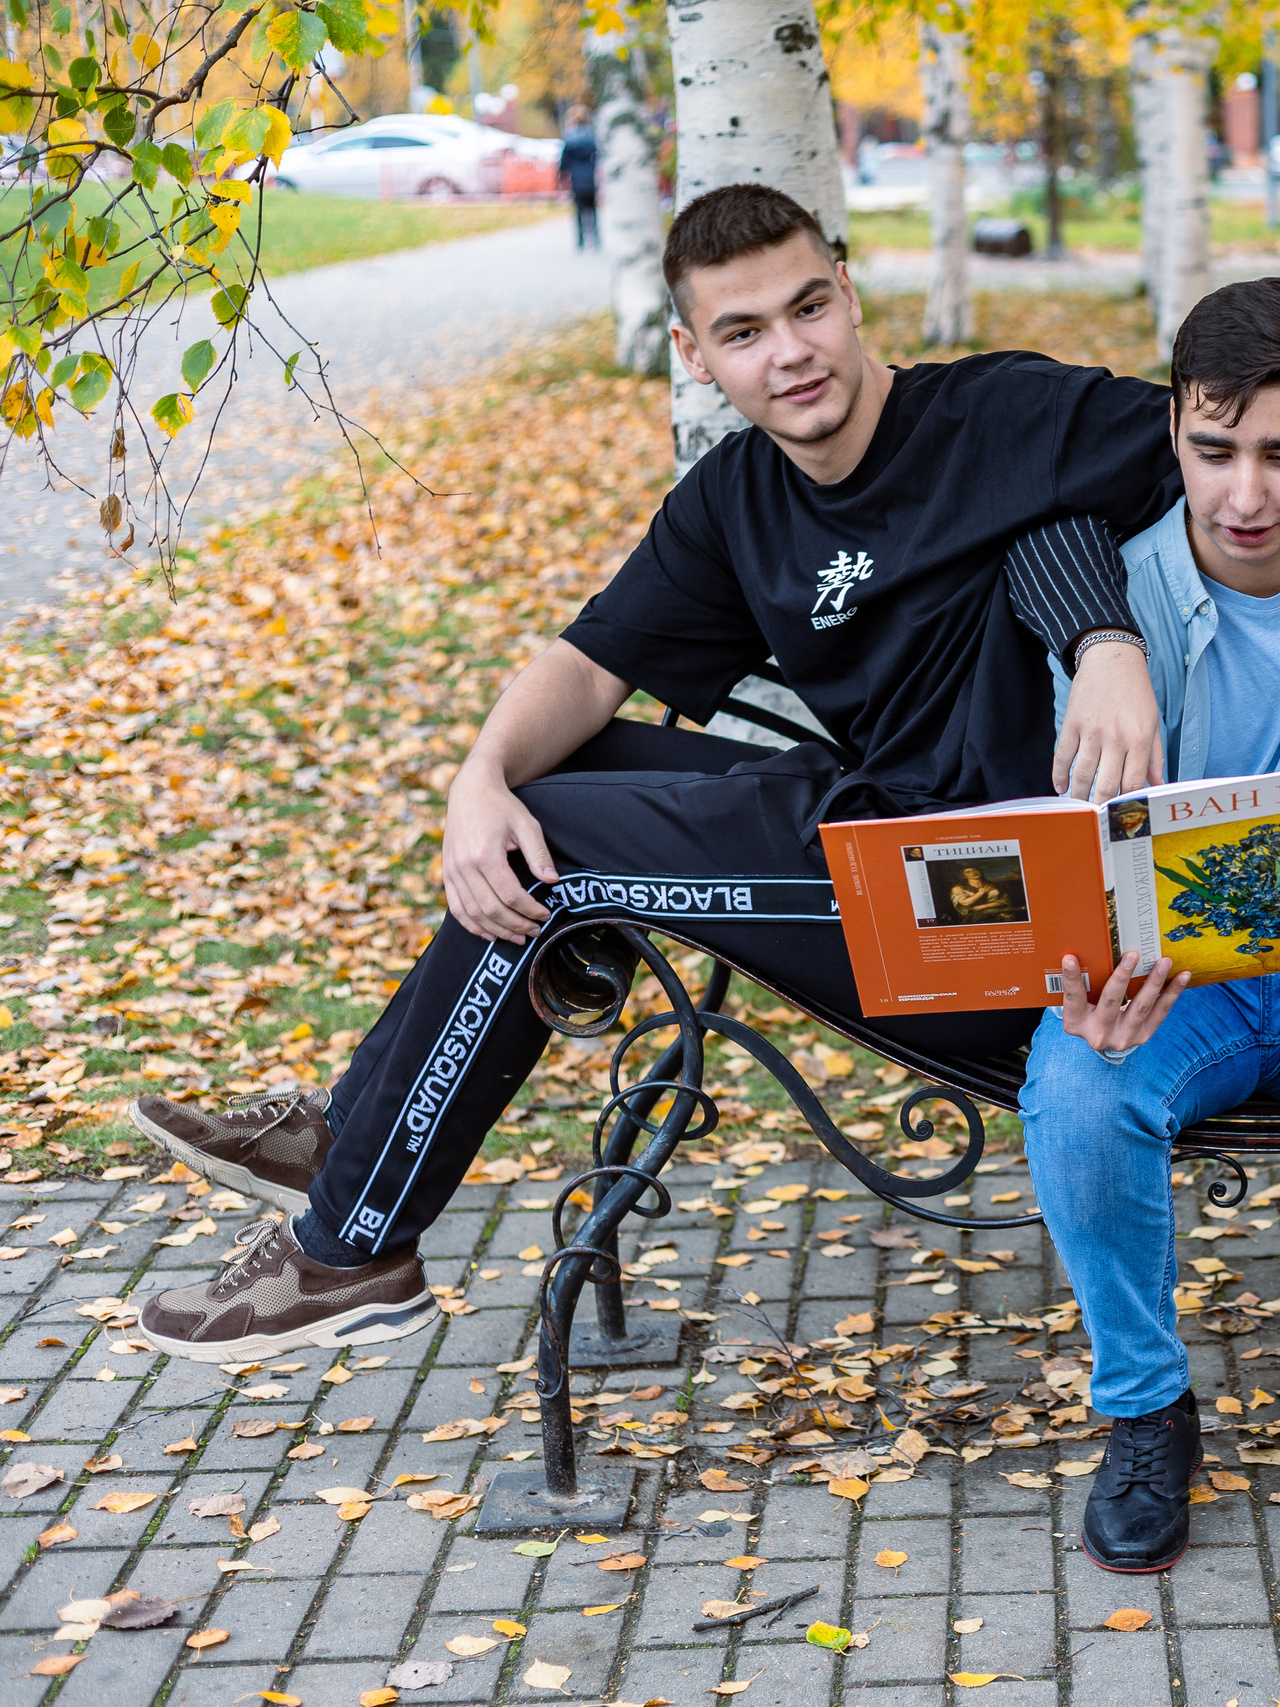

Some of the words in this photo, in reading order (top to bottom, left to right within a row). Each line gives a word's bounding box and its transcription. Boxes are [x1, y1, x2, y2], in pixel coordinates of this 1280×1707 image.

[1167, 789, 1262, 823] ВАН
[933, 845, 1009, 857] ТИЦИАН
[1131, 840, 1153, 917] ХУДОЖНИКИ
[345, 1205, 386, 1247] BL
